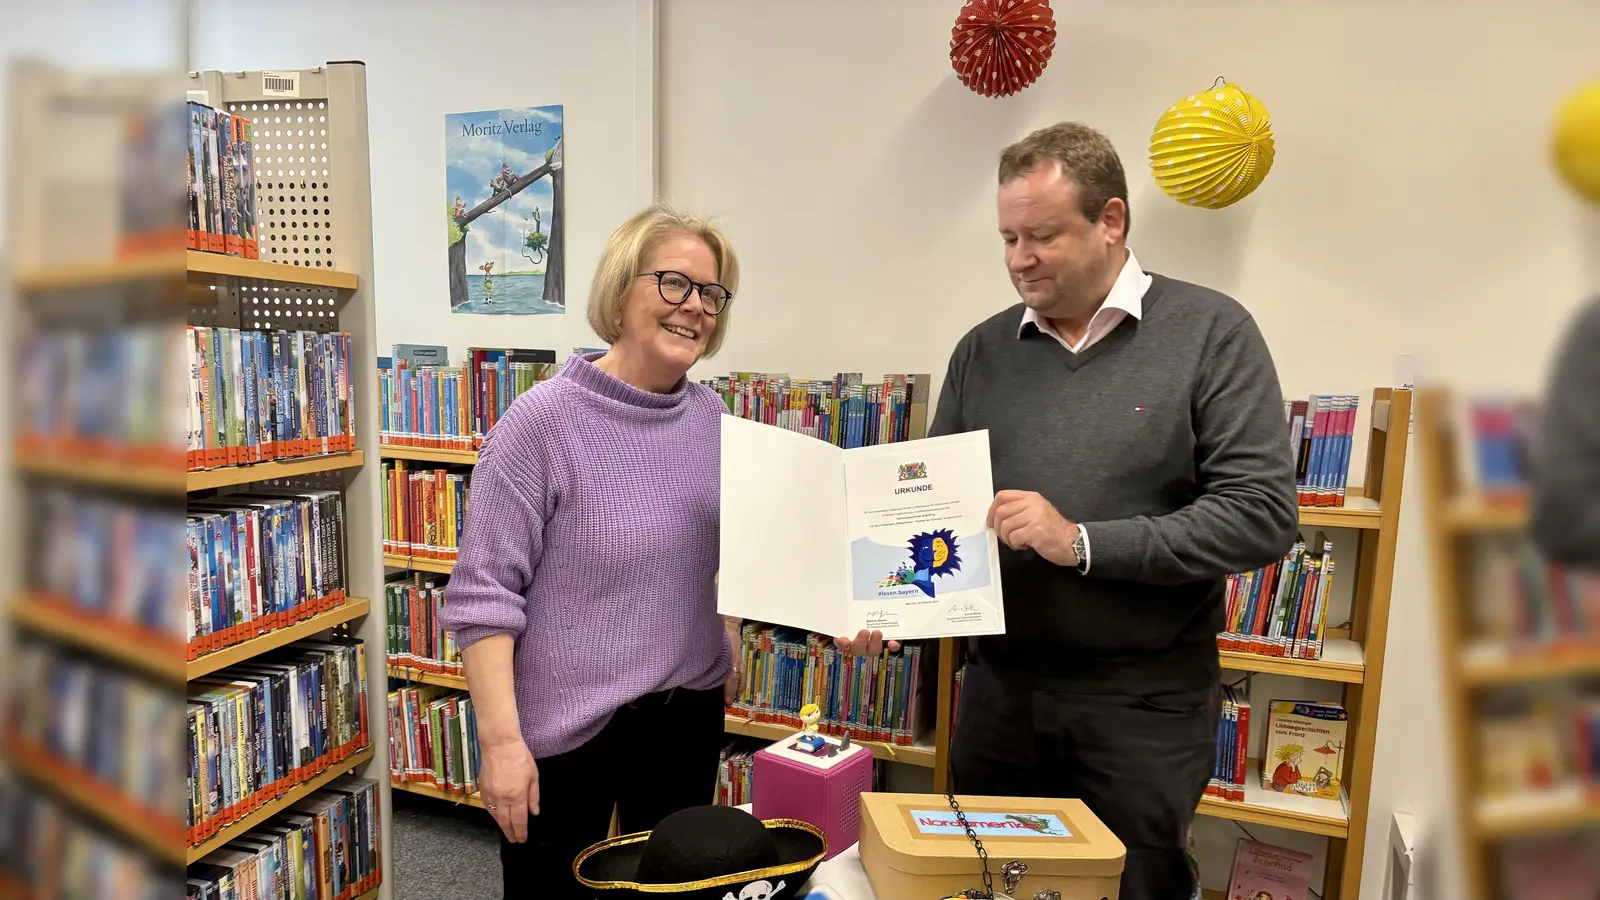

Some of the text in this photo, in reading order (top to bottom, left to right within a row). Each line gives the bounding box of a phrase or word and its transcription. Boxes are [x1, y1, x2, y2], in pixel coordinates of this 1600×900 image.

[462, 118, 542, 137] Moritz Verlag
[222, 156, 231, 208] PADDINGTON
[894, 484, 933, 495] URKUNDE
[878, 588, 919, 597] #lesen.bayern
[1275, 723, 1330, 735] Liebesgeschichten
